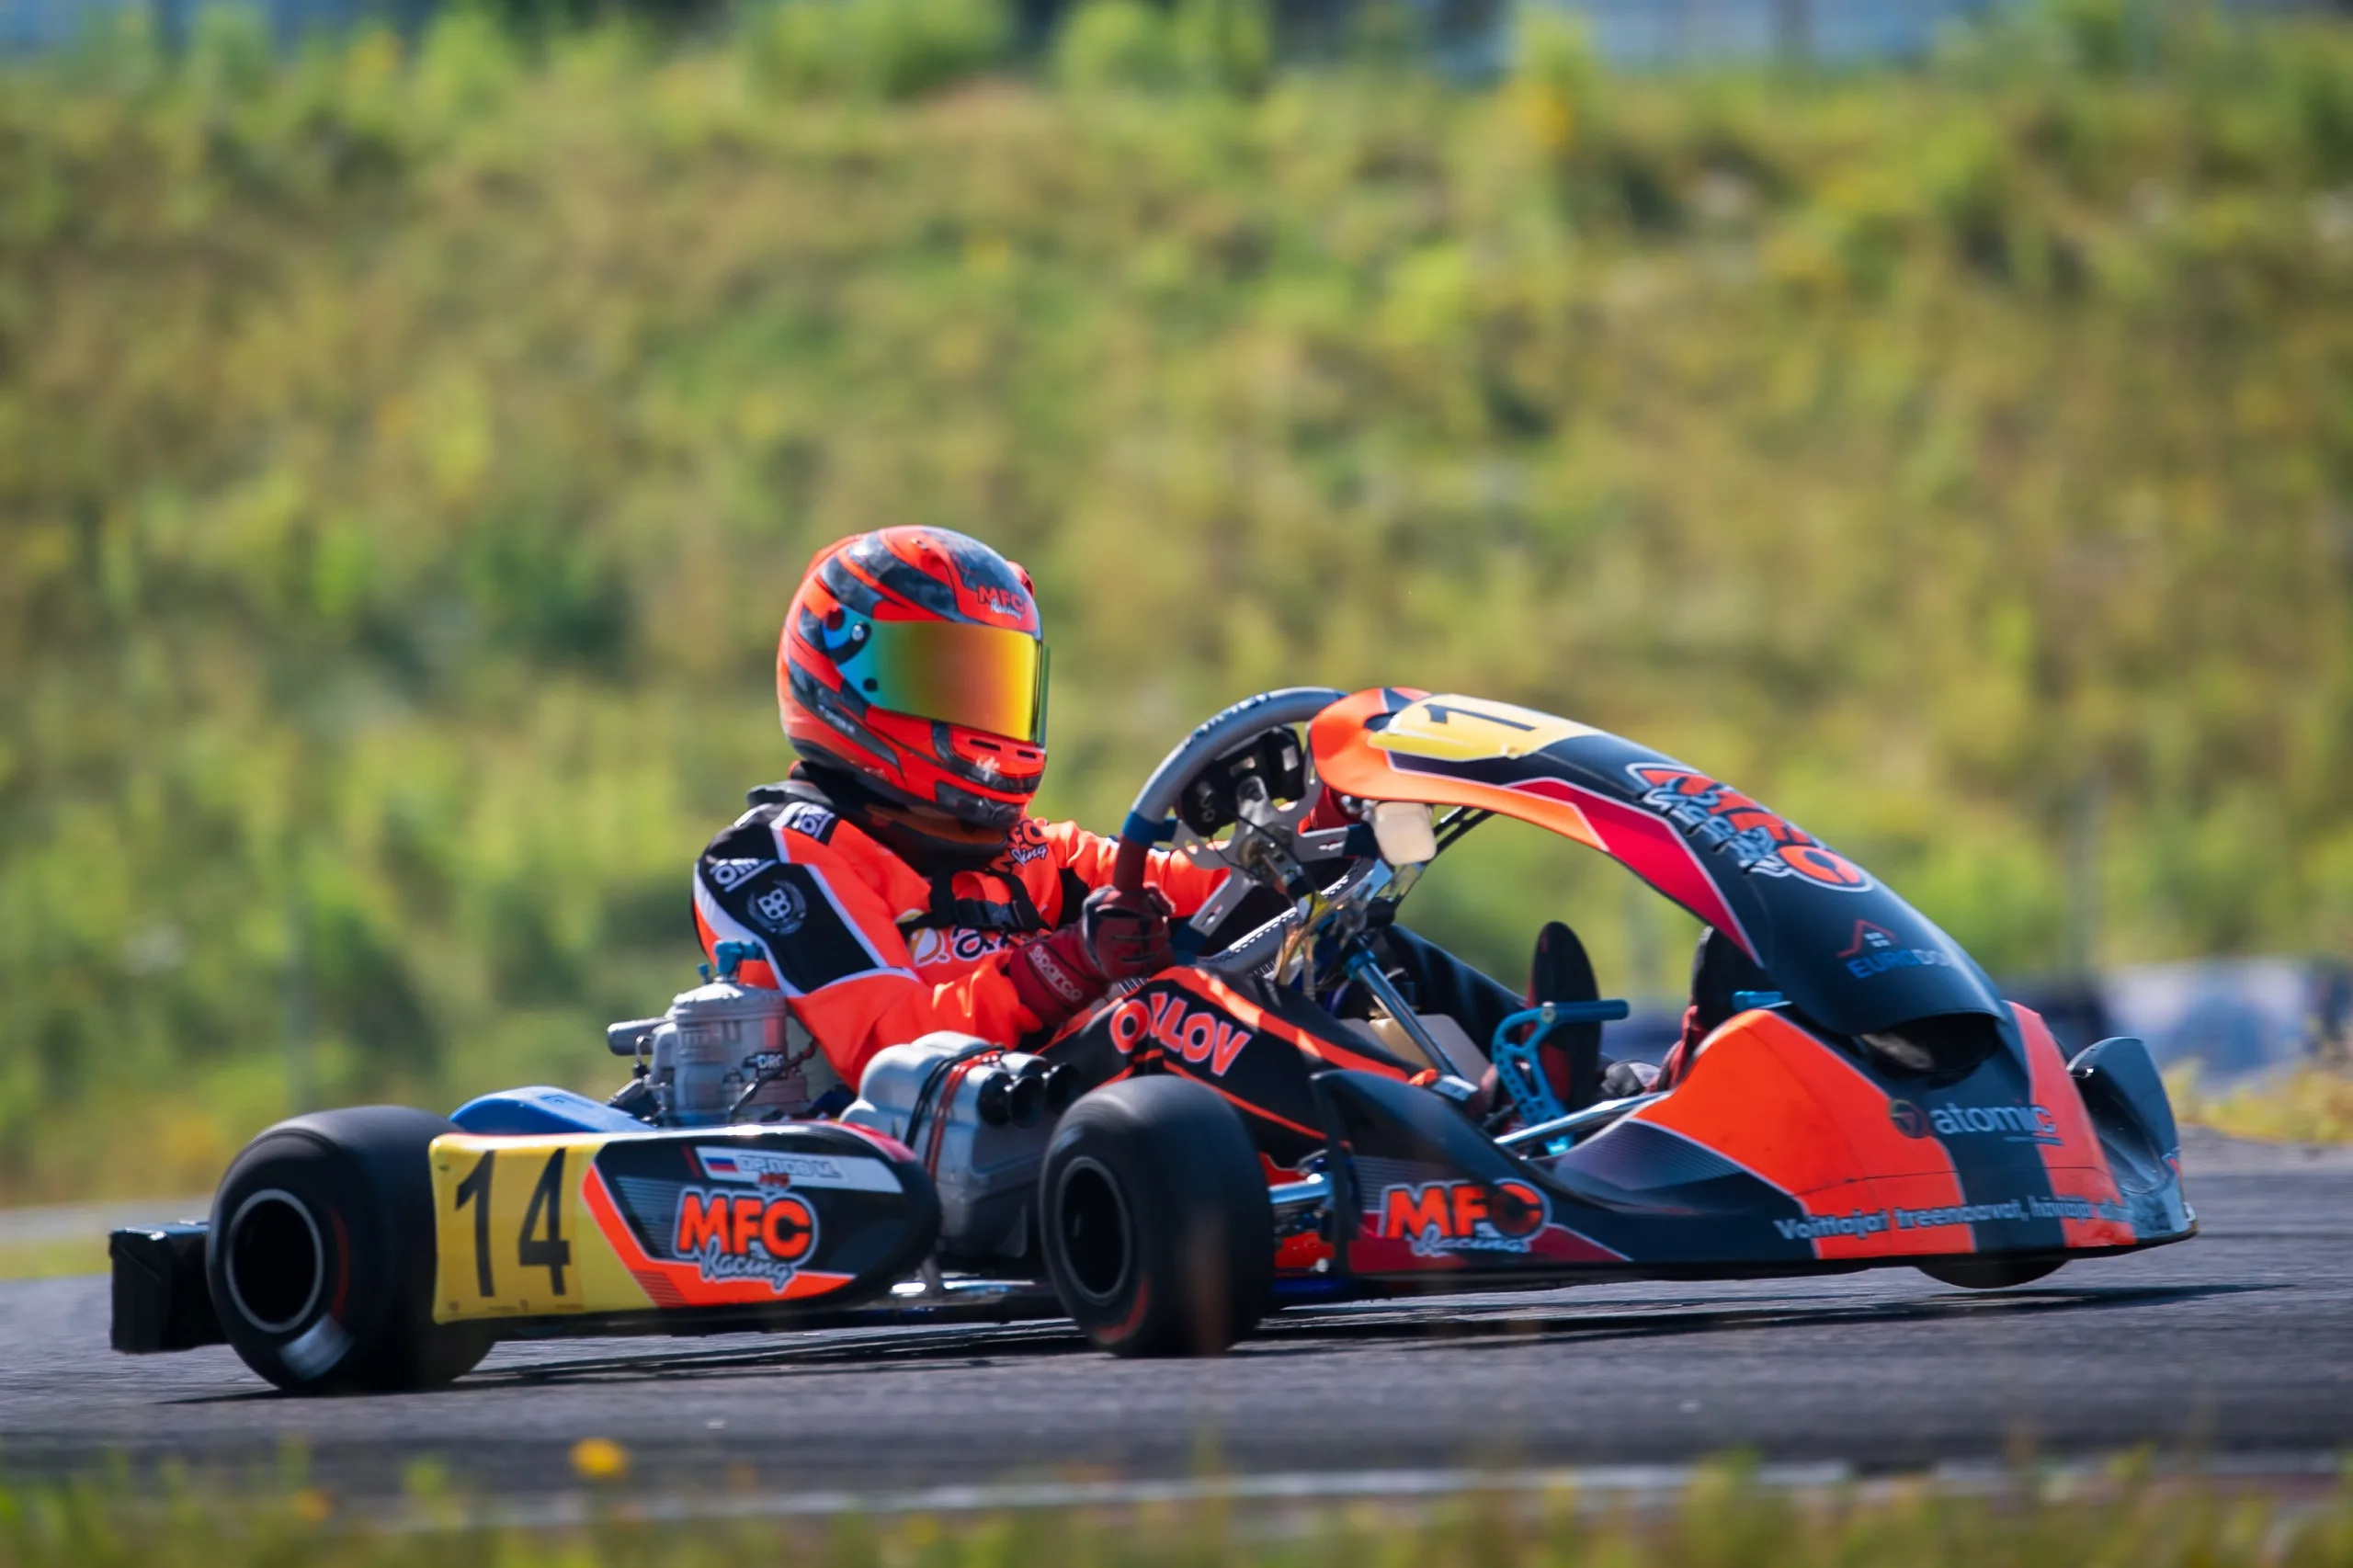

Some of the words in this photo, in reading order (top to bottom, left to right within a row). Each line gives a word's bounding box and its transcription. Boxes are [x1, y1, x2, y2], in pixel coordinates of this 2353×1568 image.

[977, 585, 1026, 615] MFC
[1931, 1103, 2056, 1133] atomic
[455, 1149, 571, 1298] 14
[677, 1195, 812, 1257] MFC
[1387, 1183, 1542, 1239] MFC
[702, 1237, 794, 1290] Racing
